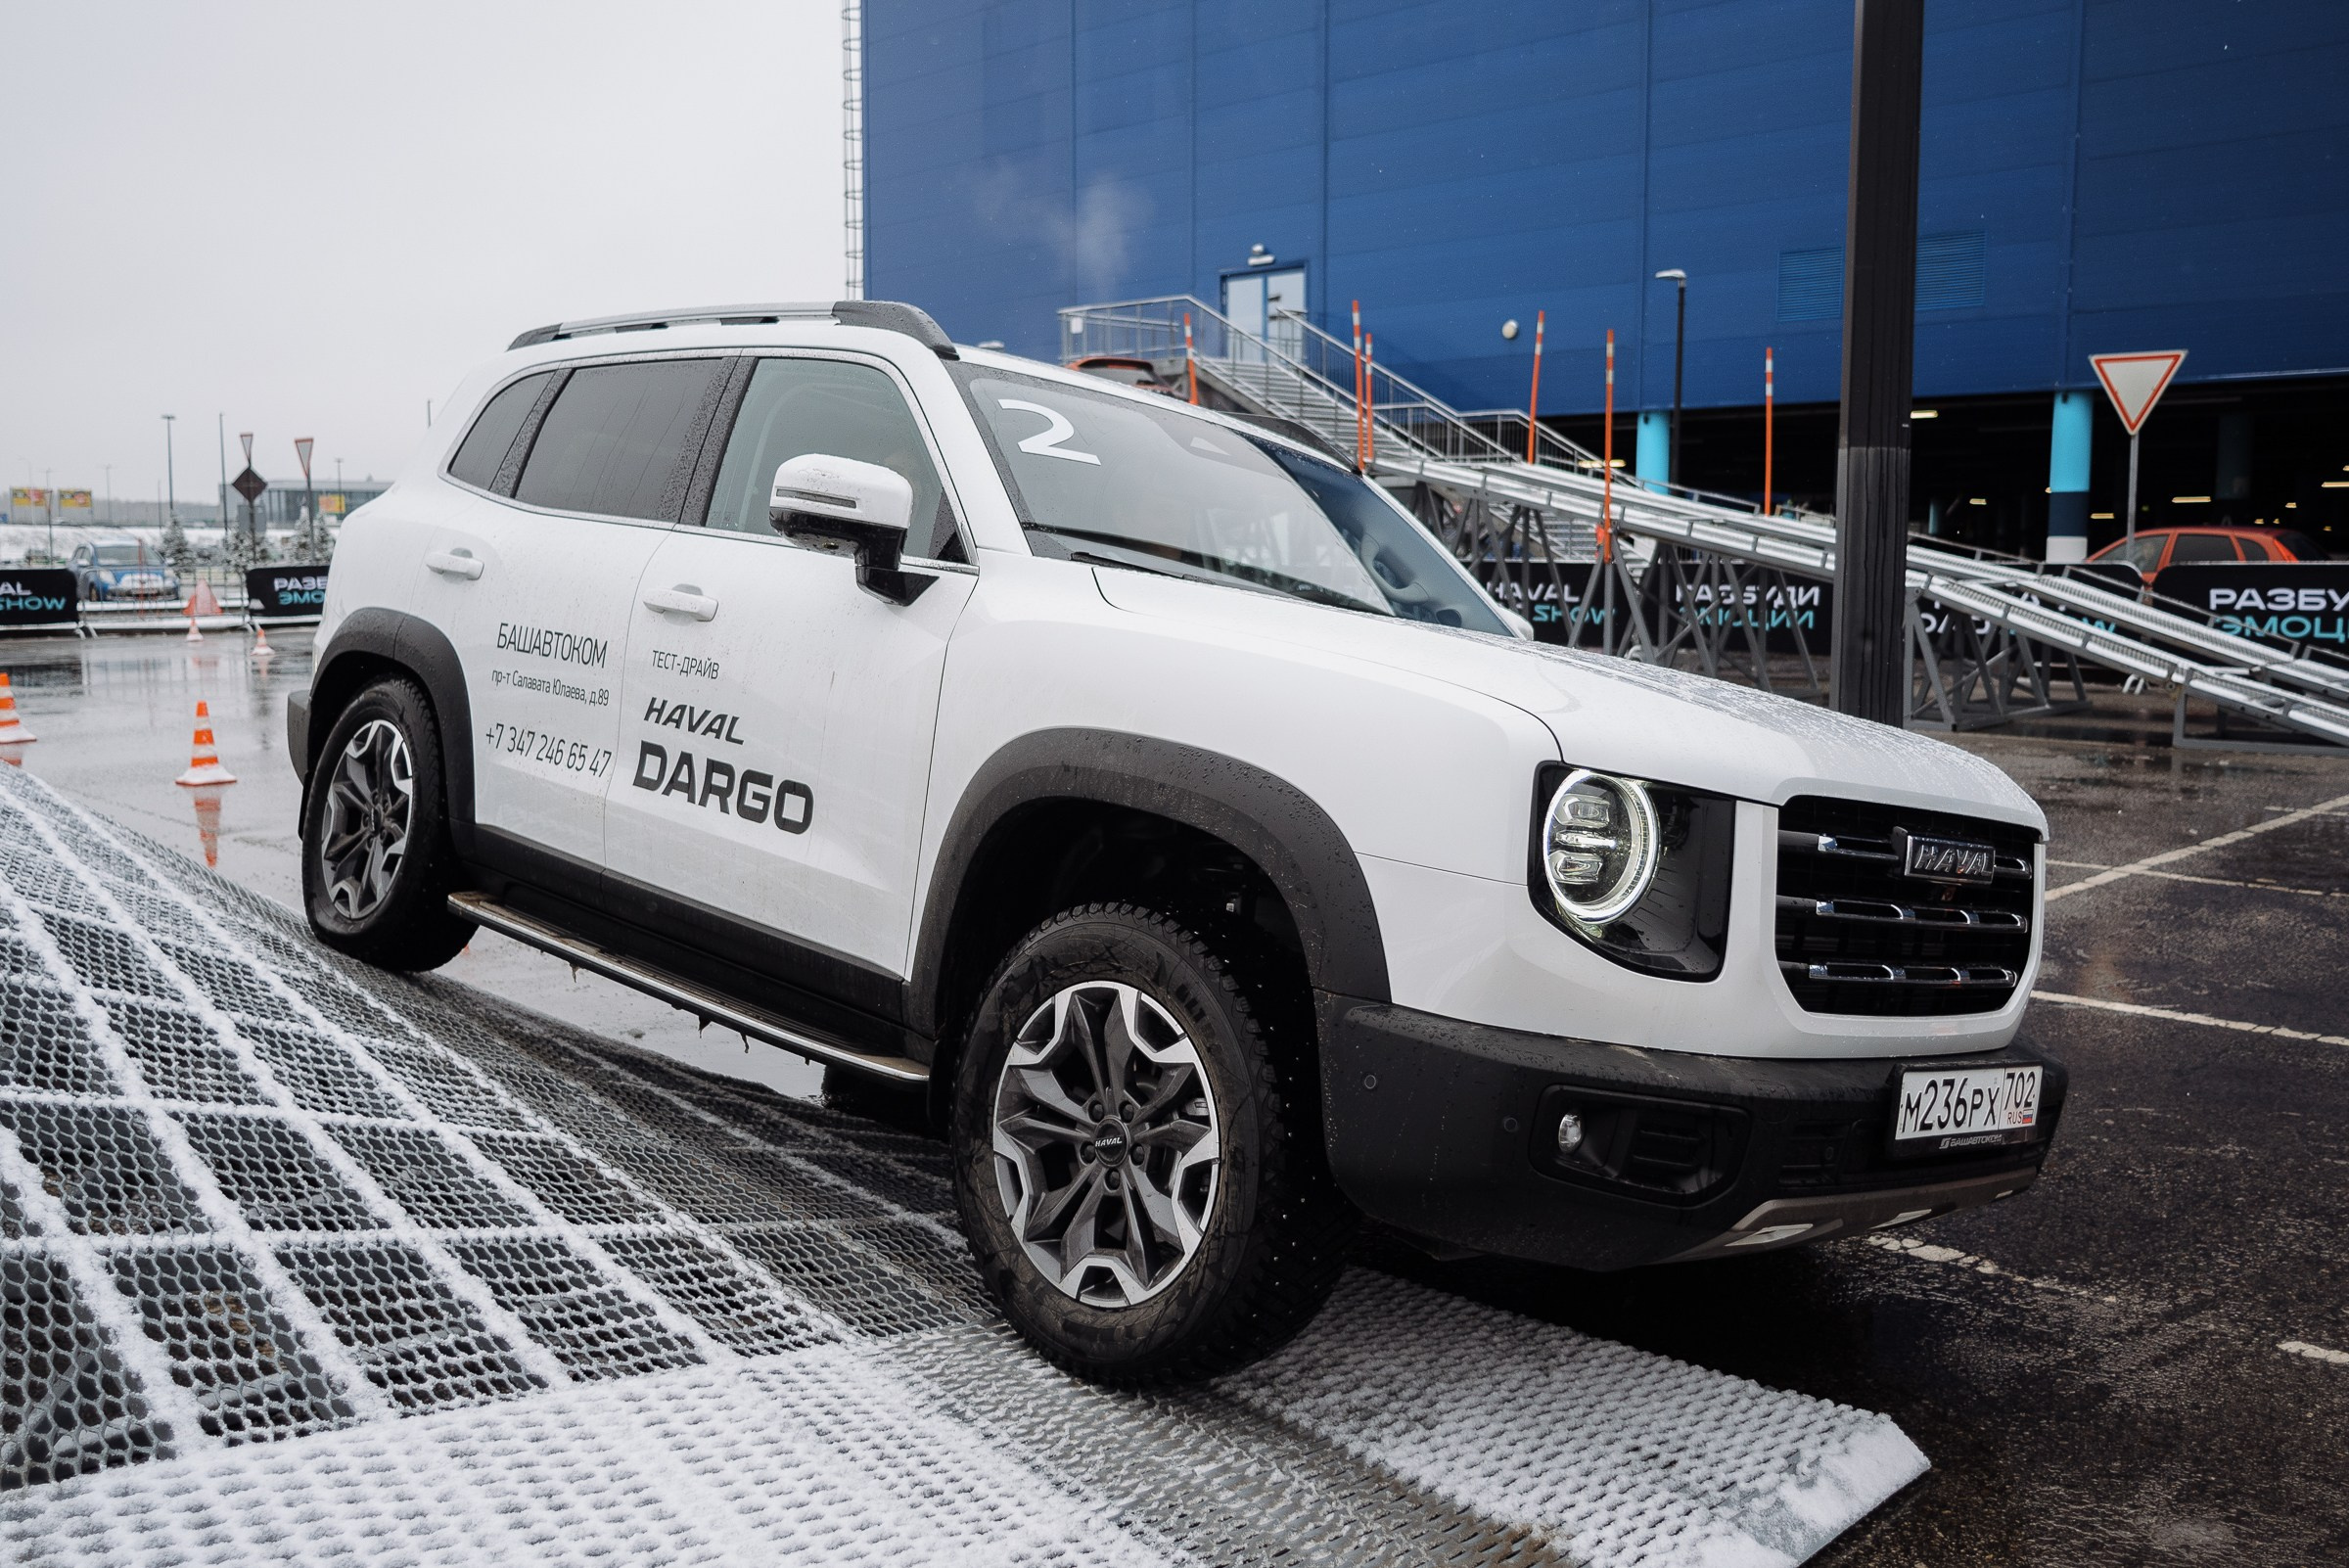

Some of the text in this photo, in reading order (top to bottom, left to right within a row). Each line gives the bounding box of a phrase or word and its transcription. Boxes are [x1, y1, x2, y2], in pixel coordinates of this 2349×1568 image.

[997, 398, 1102, 467] 2
[496, 622, 609, 669] БАШАВТОКОМ
[2215, 615, 2349, 644] ЭМОЦ
[651, 649, 720, 680] ТЕСТ-ДРАЙВ
[491, 669, 610, 707] пр-т Салавата Юлаева, д.89
[643, 696, 745, 746] HAVAL
[485, 722, 613, 778] +7 347 246 65 47
[632, 739, 814, 835] DARGO
[1913, 844, 1993, 877] HAVAL
[2004, 1071, 2036, 1111] 702
[2006, 1111, 2023, 1125] RUS
[1094, 1136, 1123, 1147] HAVAL
